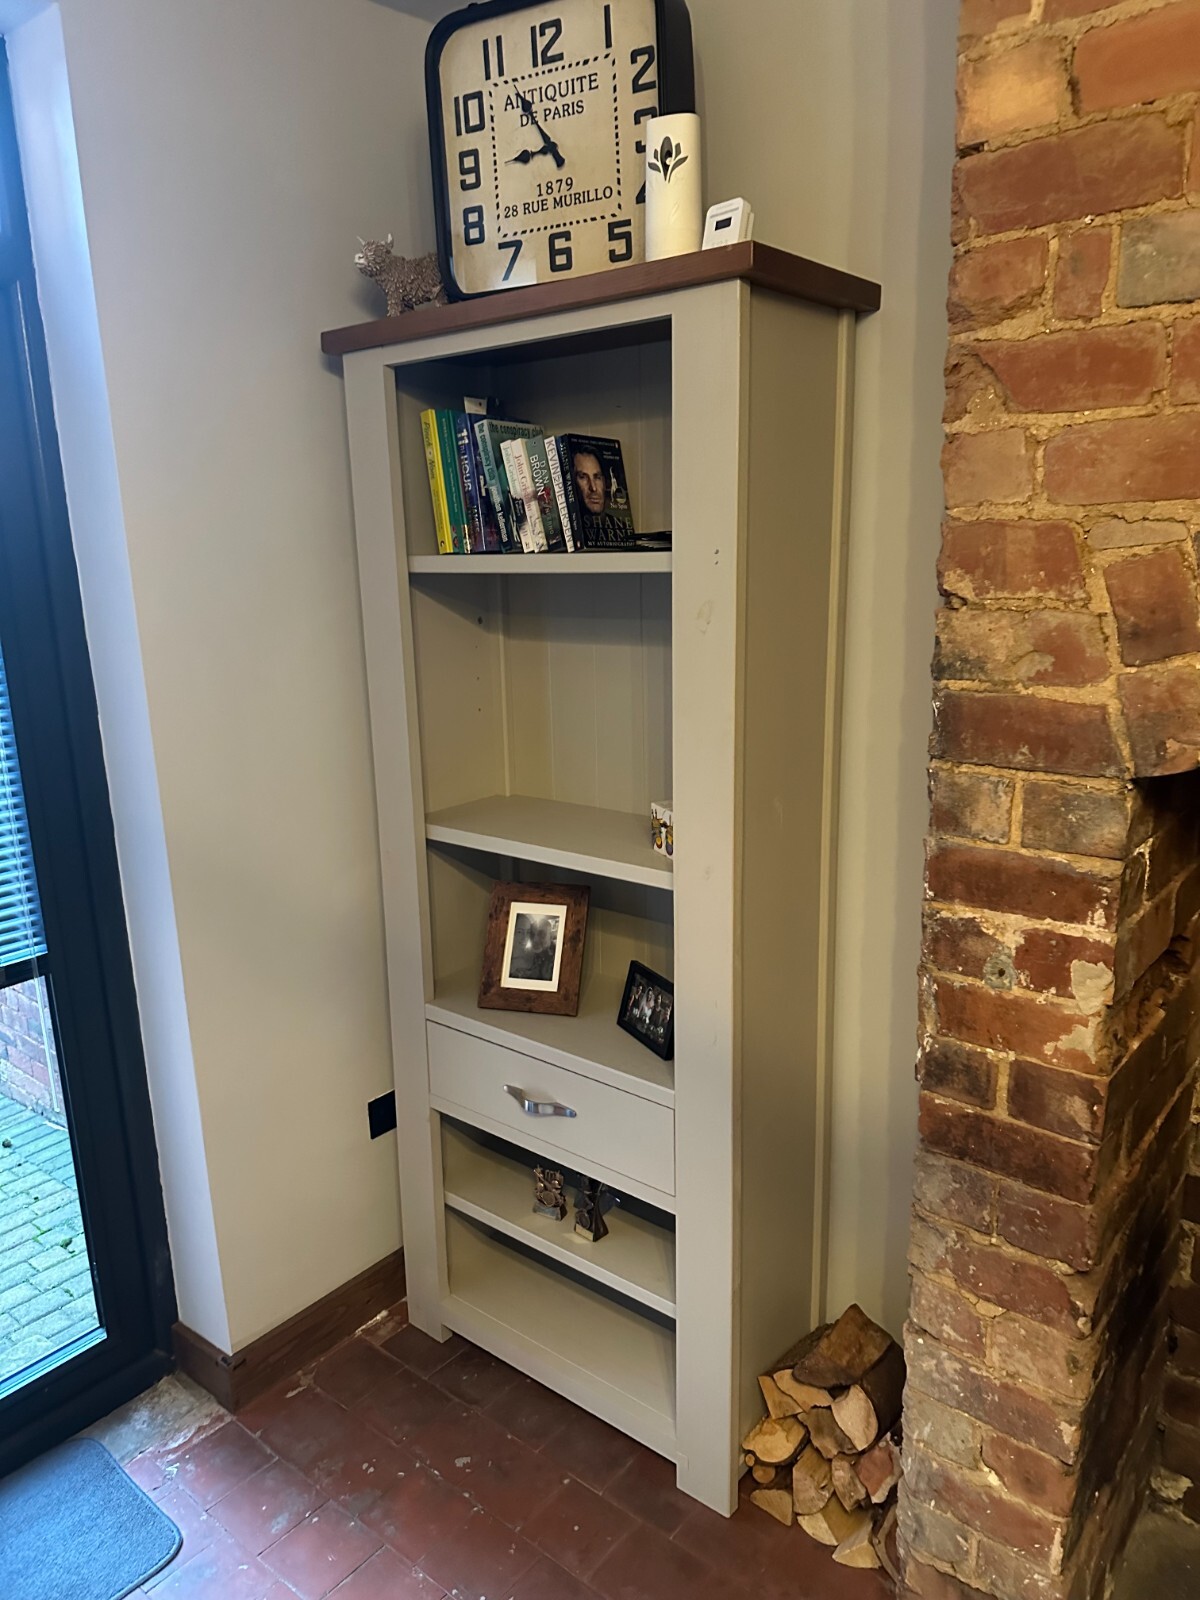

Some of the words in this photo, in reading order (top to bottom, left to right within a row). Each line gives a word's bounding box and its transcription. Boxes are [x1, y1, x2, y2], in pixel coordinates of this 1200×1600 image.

[530, 18, 564, 68] 12
[603, 4, 613, 49] 1
[482, 35, 505, 81] 11
[630, 44, 657, 94] 2
[503, 72, 599, 112] ANTIQUITE
[453, 90, 486, 137] 10
[519, 111, 538, 128] DE
[543, 100, 585, 121] PARIS
[458, 148, 482, 191] 9
[536, 176, 575, 197] 1879
[504, 204, 519, 219] 28
[522, 198, 549, 216] RUE
[552, 185, 614, 210] MURILLO
[462, 204, 486, 246] 8
[607, 218, 633, 263] 5
[497, 239, 524, 282] 7
[548, 230, 573, 273] 6
[461, 455, 472, 491] HOUR
[514, 454, 524, 475] John
[529, 454, 546, 496] BROWN
[540, 460, 550, 484] DAN
[546, 440, 561, 475] KEVIN
[555, 481, 574, 543] PIETERSEN
[566, 472, 575, 503] WARNE
[583, 515, 633, 530] SHANE
